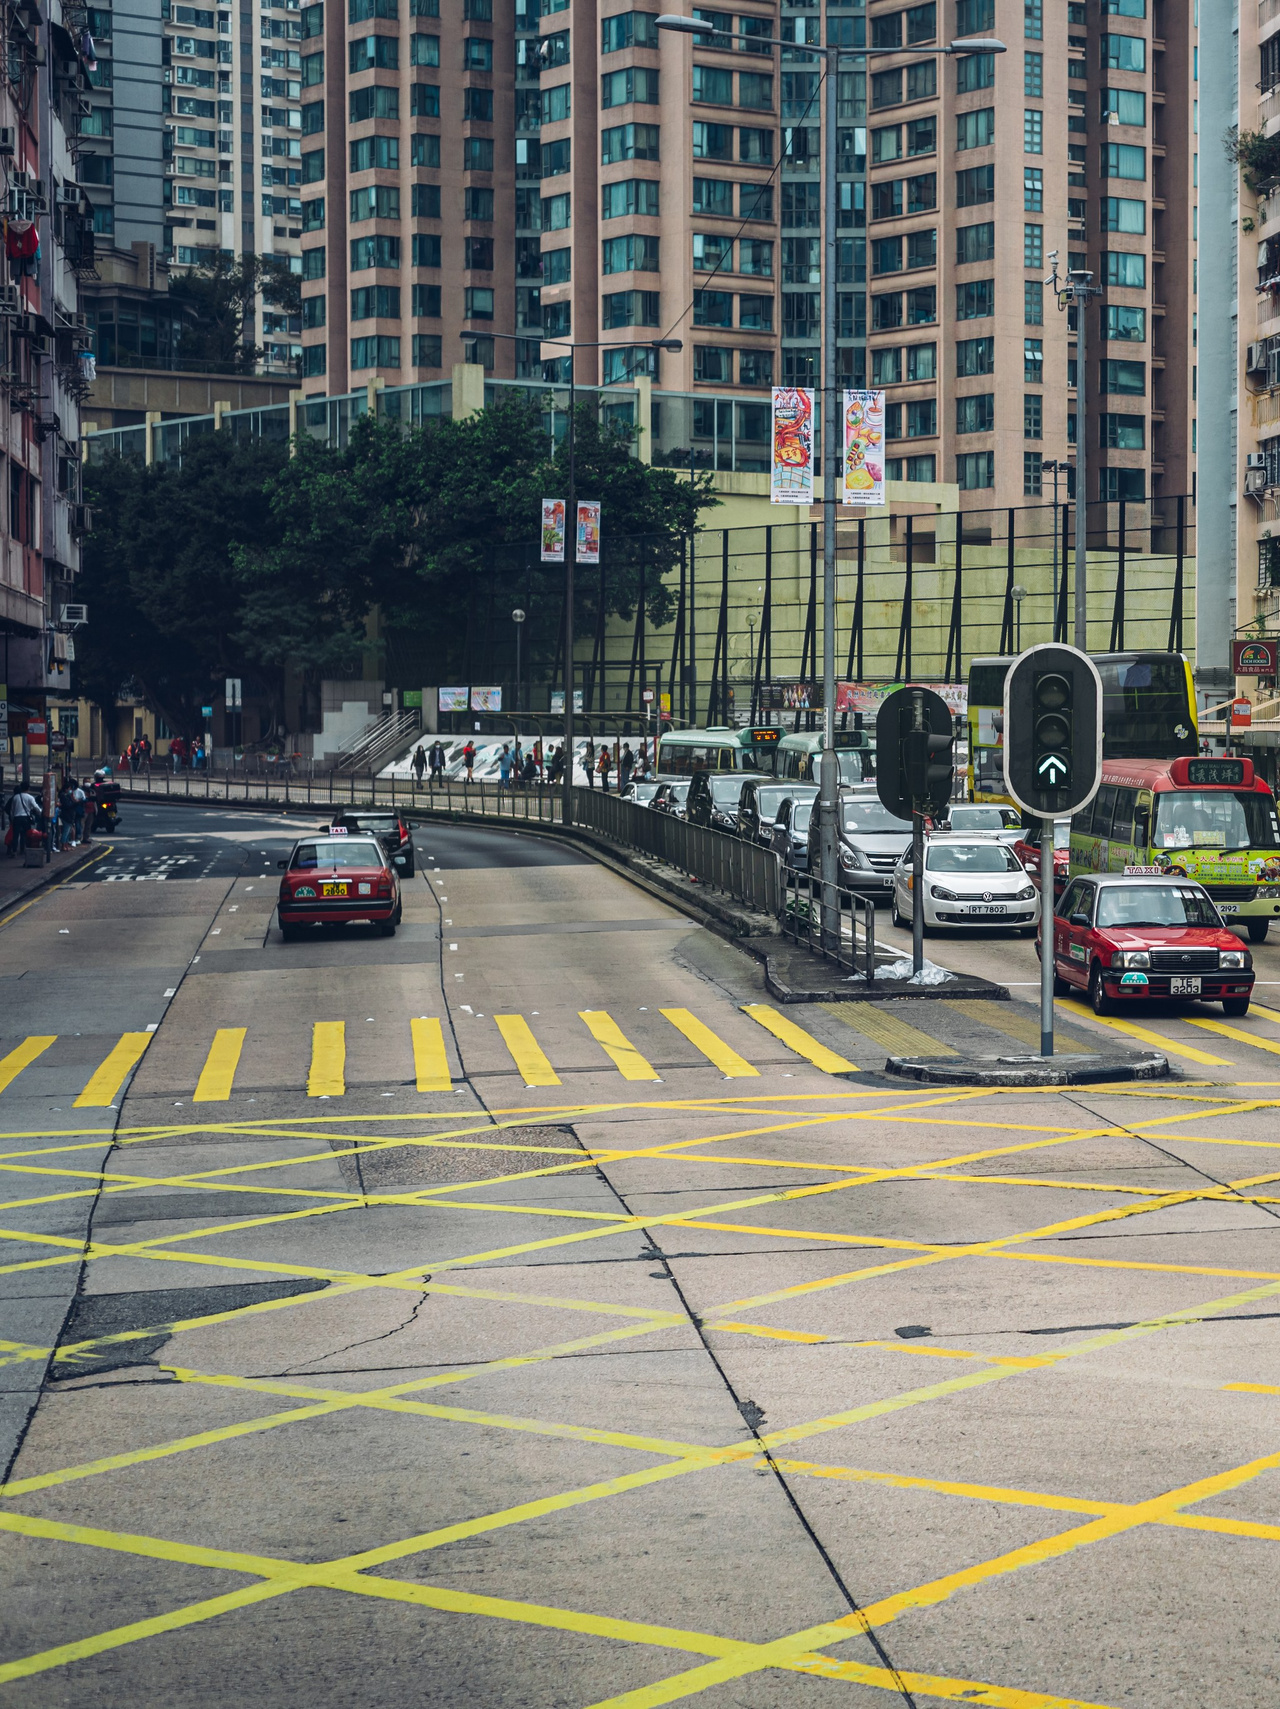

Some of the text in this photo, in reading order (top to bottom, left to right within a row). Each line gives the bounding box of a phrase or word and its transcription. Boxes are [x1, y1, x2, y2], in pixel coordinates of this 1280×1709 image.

[1126, 866, 1159, 874] TAXI
[971, 906, 1005, 914] RT 7802
[1219, 905, 1238, 913] 2192
[1172, 985, 1199, 994] 3203
